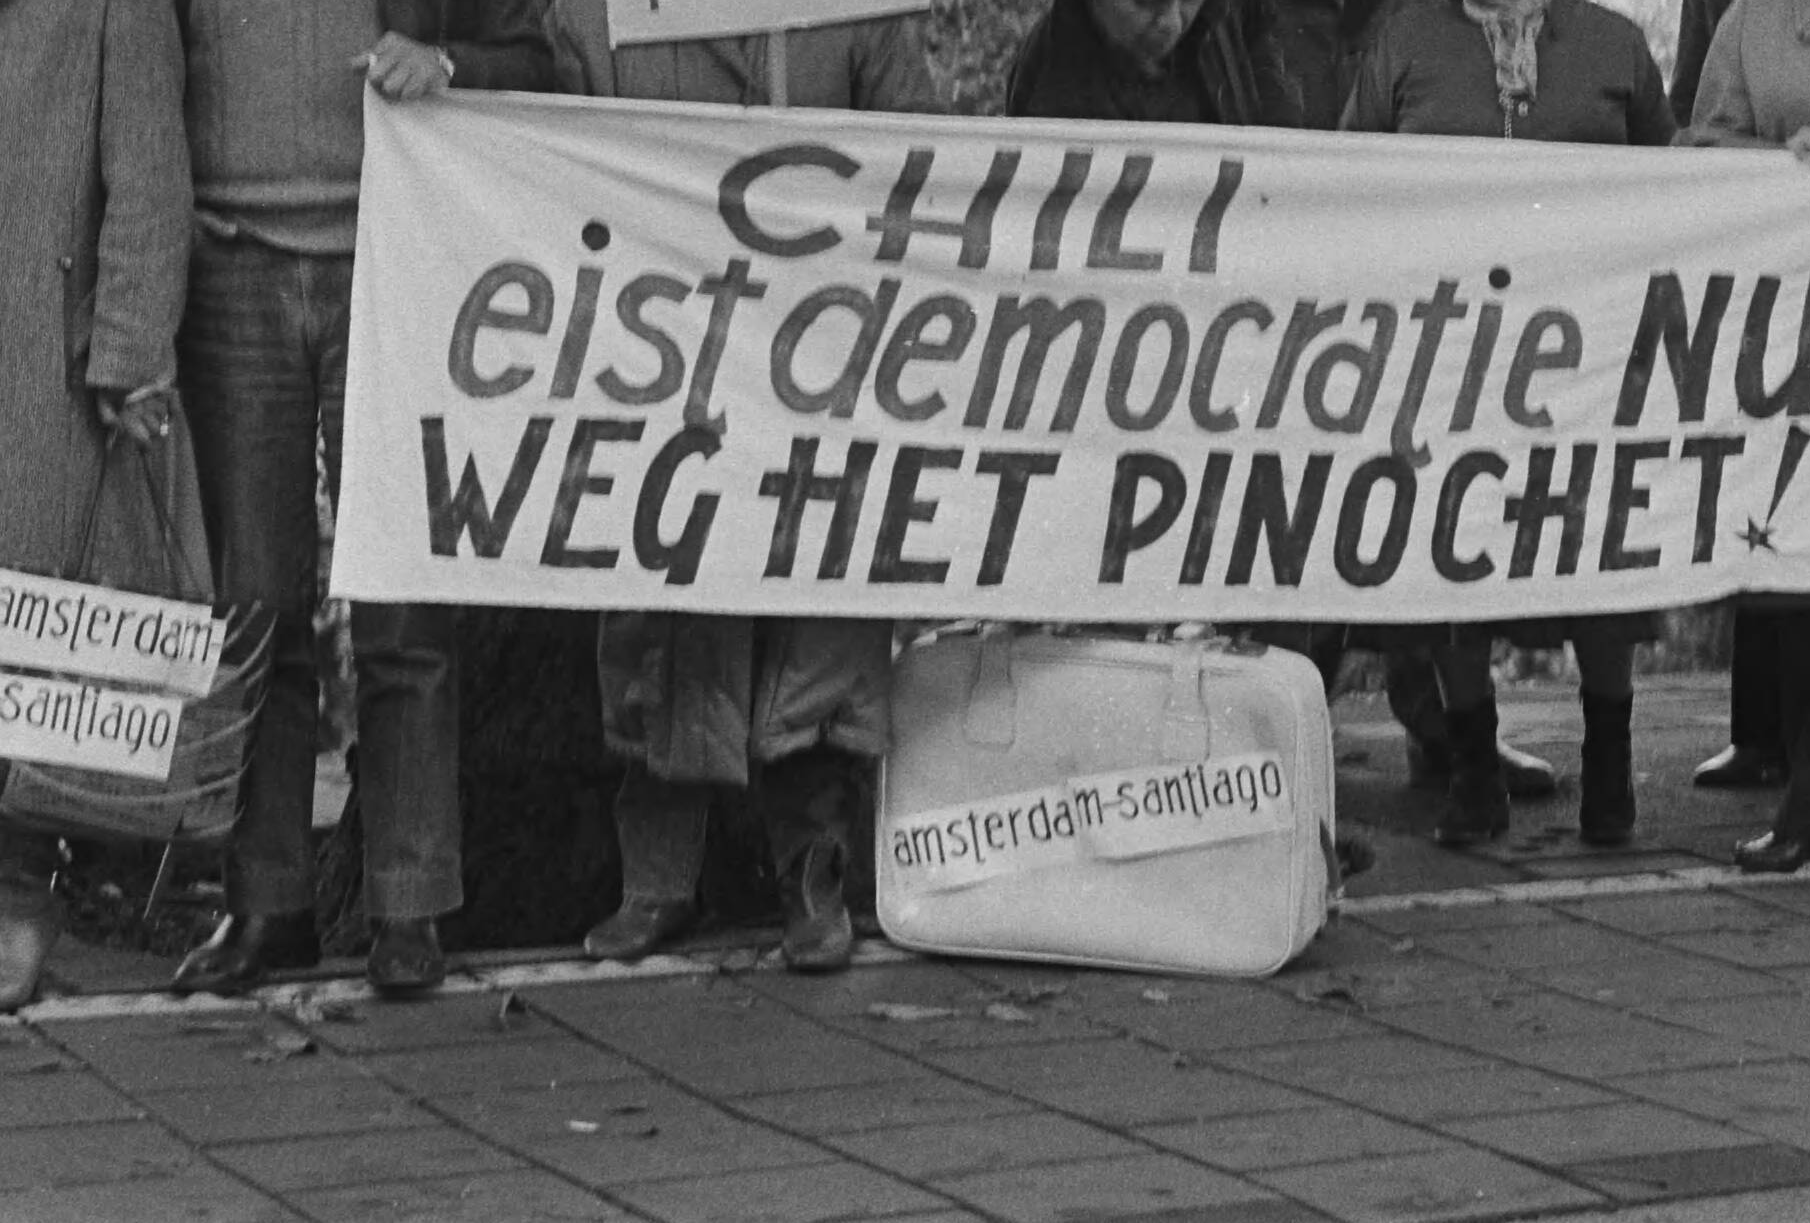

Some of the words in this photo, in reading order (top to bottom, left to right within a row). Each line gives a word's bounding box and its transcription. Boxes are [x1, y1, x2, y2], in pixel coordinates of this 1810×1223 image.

[718, 144, 1245, 273] CHILI
[447, 220, 767, 435] eist
[769, 265, 1584, 469] democratie
[420, 415, 723, 585] WEG
[758, 434, 1063, 586] HET
[0, 680, 171, 755] santiago
